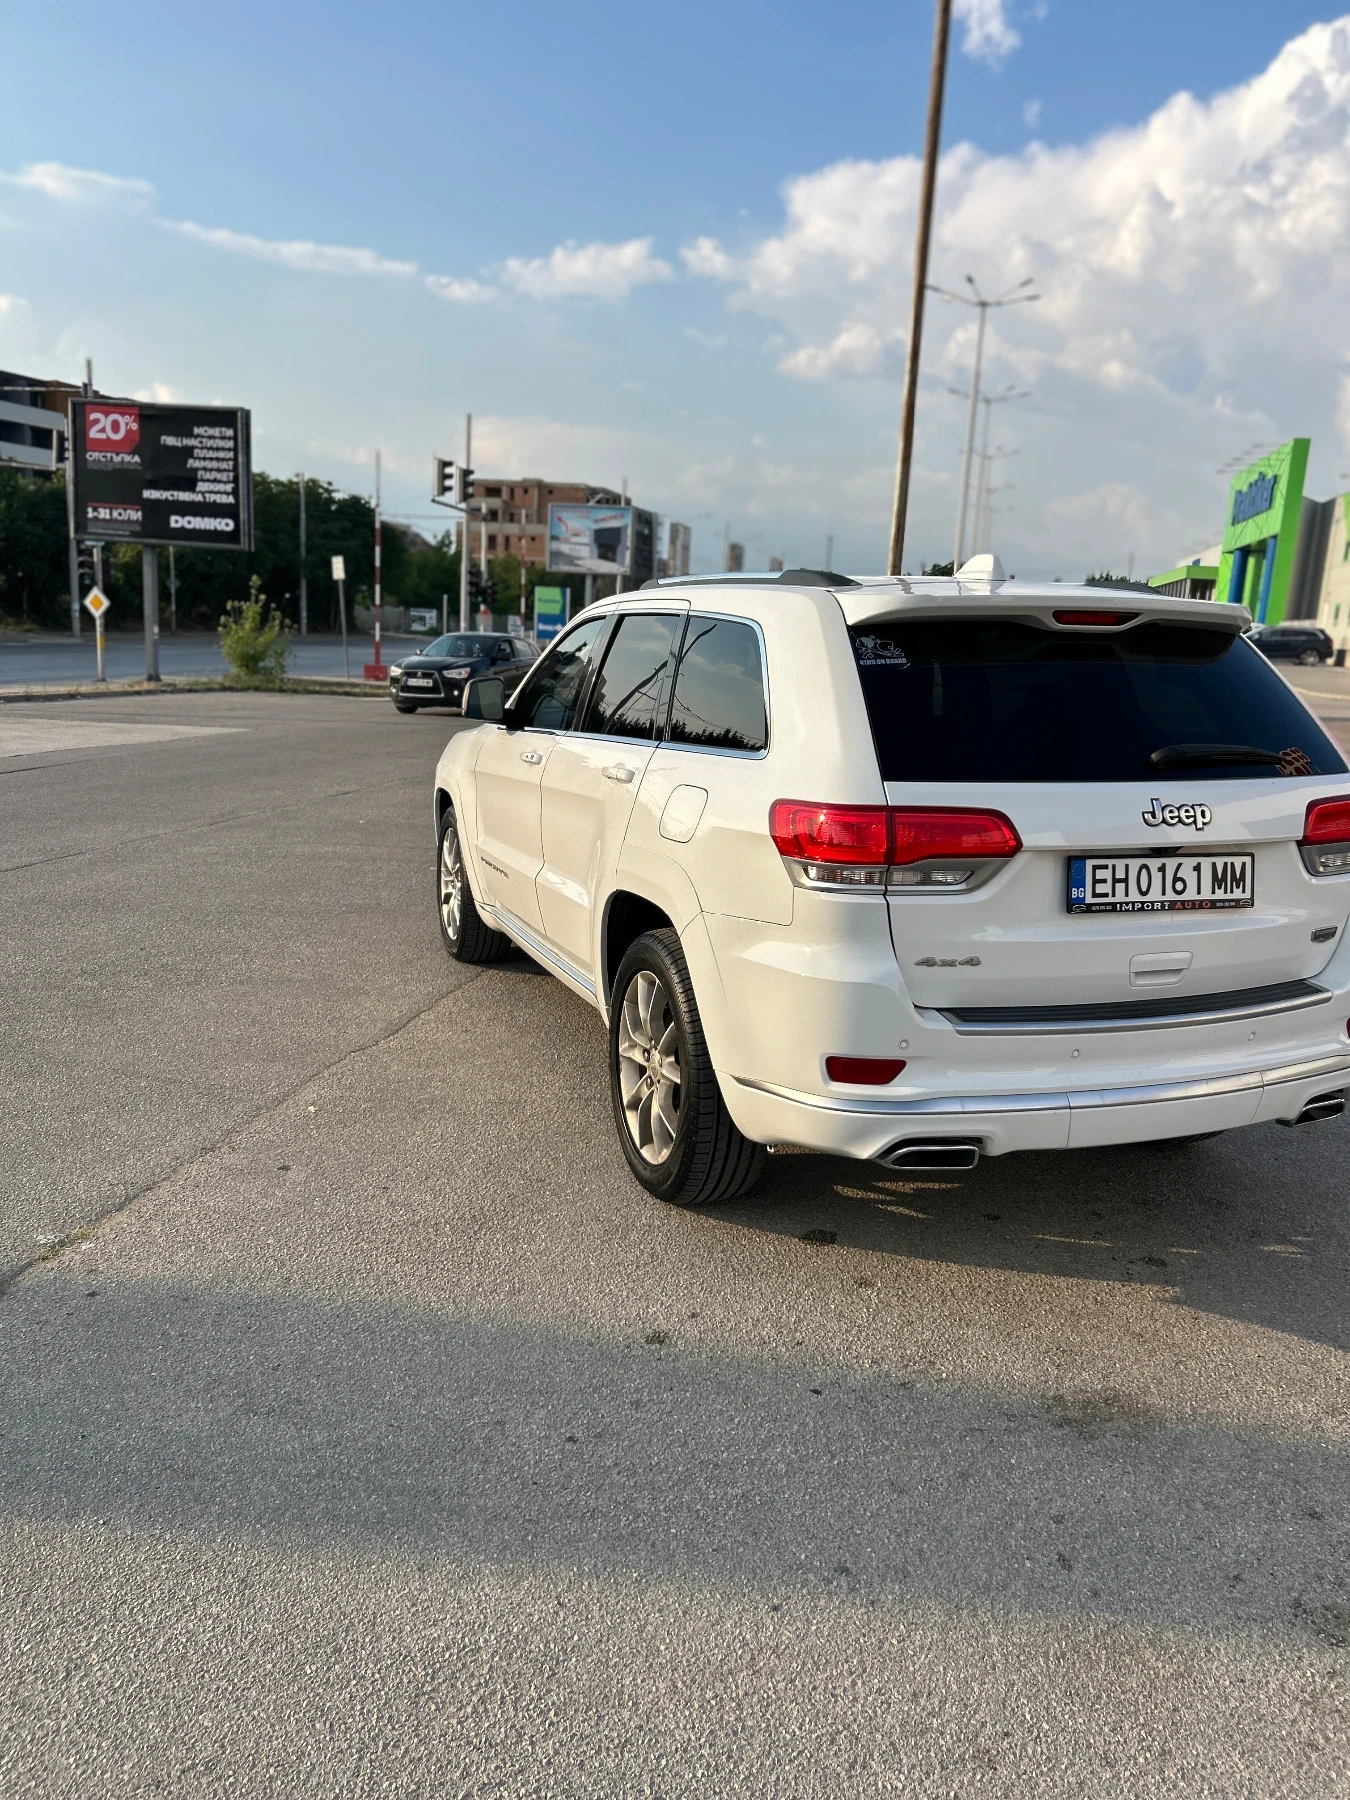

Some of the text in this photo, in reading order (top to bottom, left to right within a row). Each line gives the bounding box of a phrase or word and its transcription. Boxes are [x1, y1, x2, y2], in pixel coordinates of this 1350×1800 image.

[89, 412, 138, 440] 20%
[193, 426, 234, 437] МОКЕТИ
[182, 437, 234, 449] НАСТИЛКИ
[86, 451, 141, 463] ОТСТЪПКА
[193, 448, 234, 459] ПЛАНКИ
[186, 458, 234, 470] ЛАМИНАТ
[197, 470, 234, 481] ПАРКЕТ
[195, 481, 235, 493] ДЕКИНГ
[142, 489, 235, 504] ИЗКУСТВЕНА ТРЕВА
[87, 507, 142, 521] 1-31 ЮЛИ
[170, 515, 235, 531] DOMKO
[1142, 797, 1212, 831] Jeep
[1072, 887, 1085, 899] BG
[1116, 902, 1171, 911] IMPORT
[1174, 901, 1211, 910] AUTO
